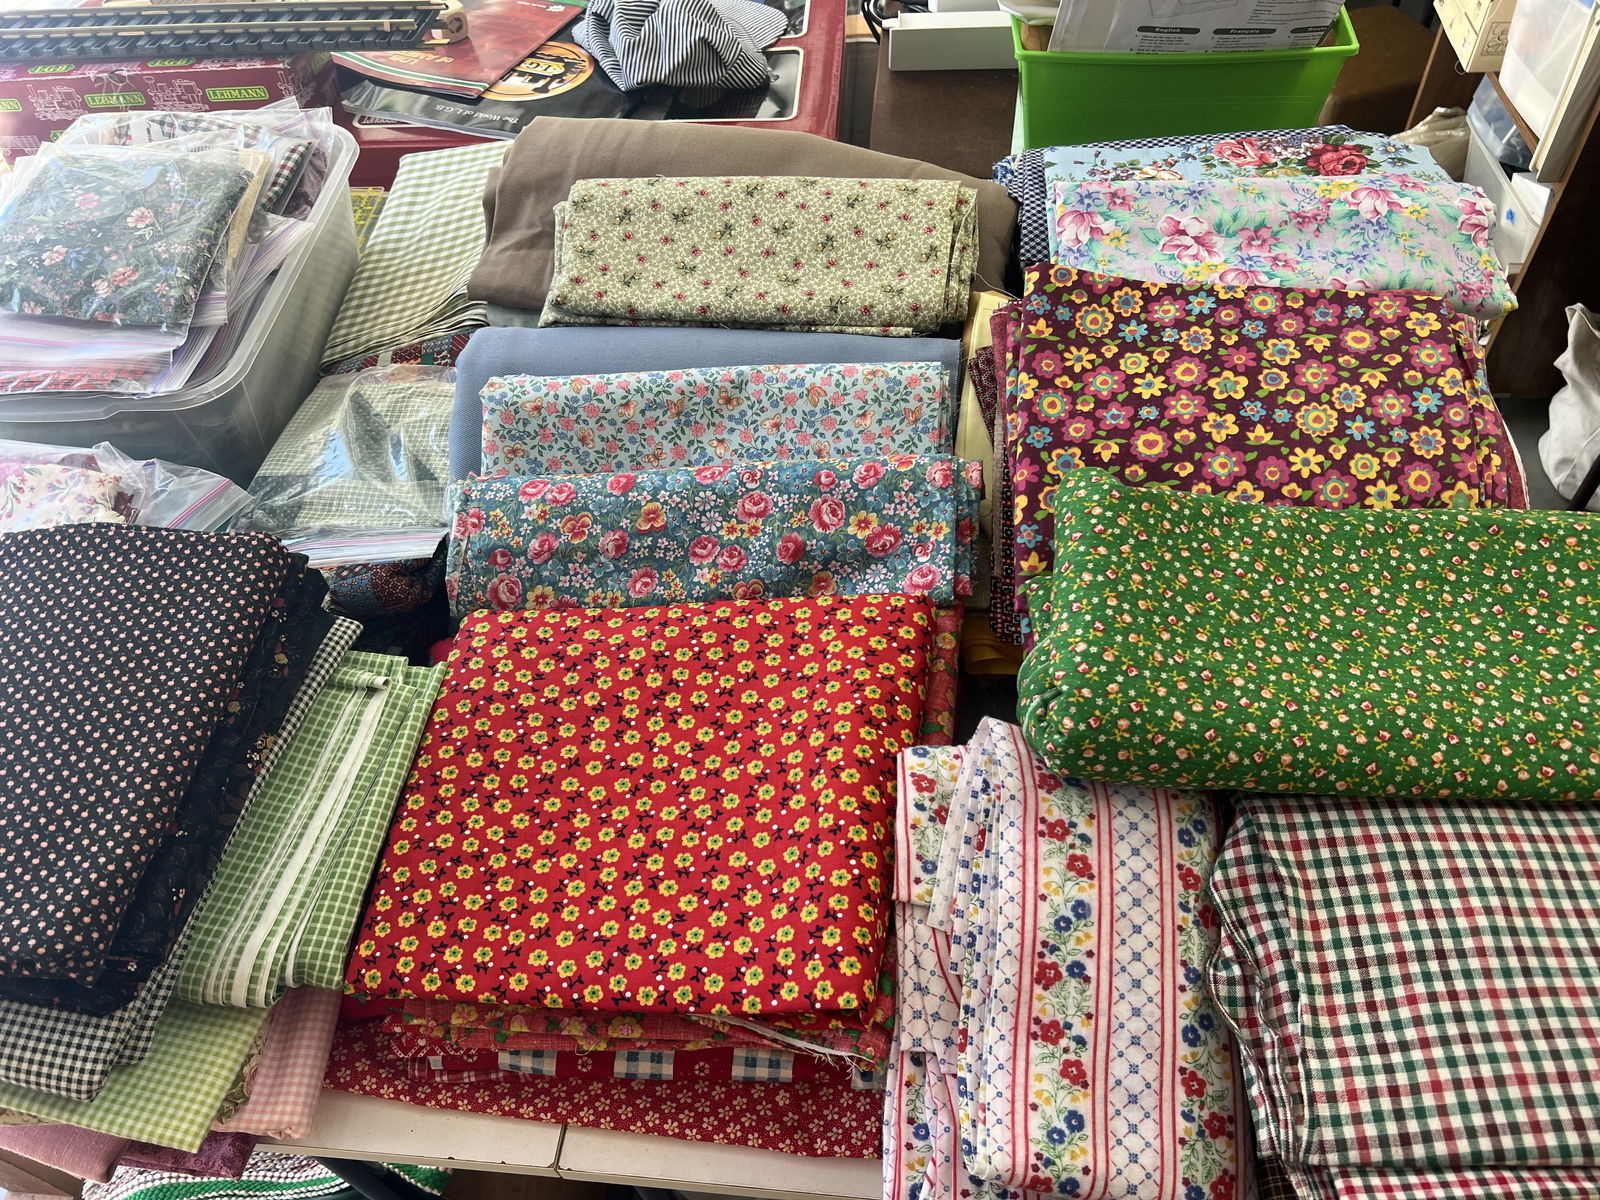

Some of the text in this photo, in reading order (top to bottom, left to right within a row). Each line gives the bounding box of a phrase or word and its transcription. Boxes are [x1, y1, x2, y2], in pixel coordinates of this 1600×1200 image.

[208, 87, 266, 100] LEHMANN
[88, 94, 143, 105] LEHMANN
[473, 112, 501, 121] World
[503, 116, 519, 124] The
